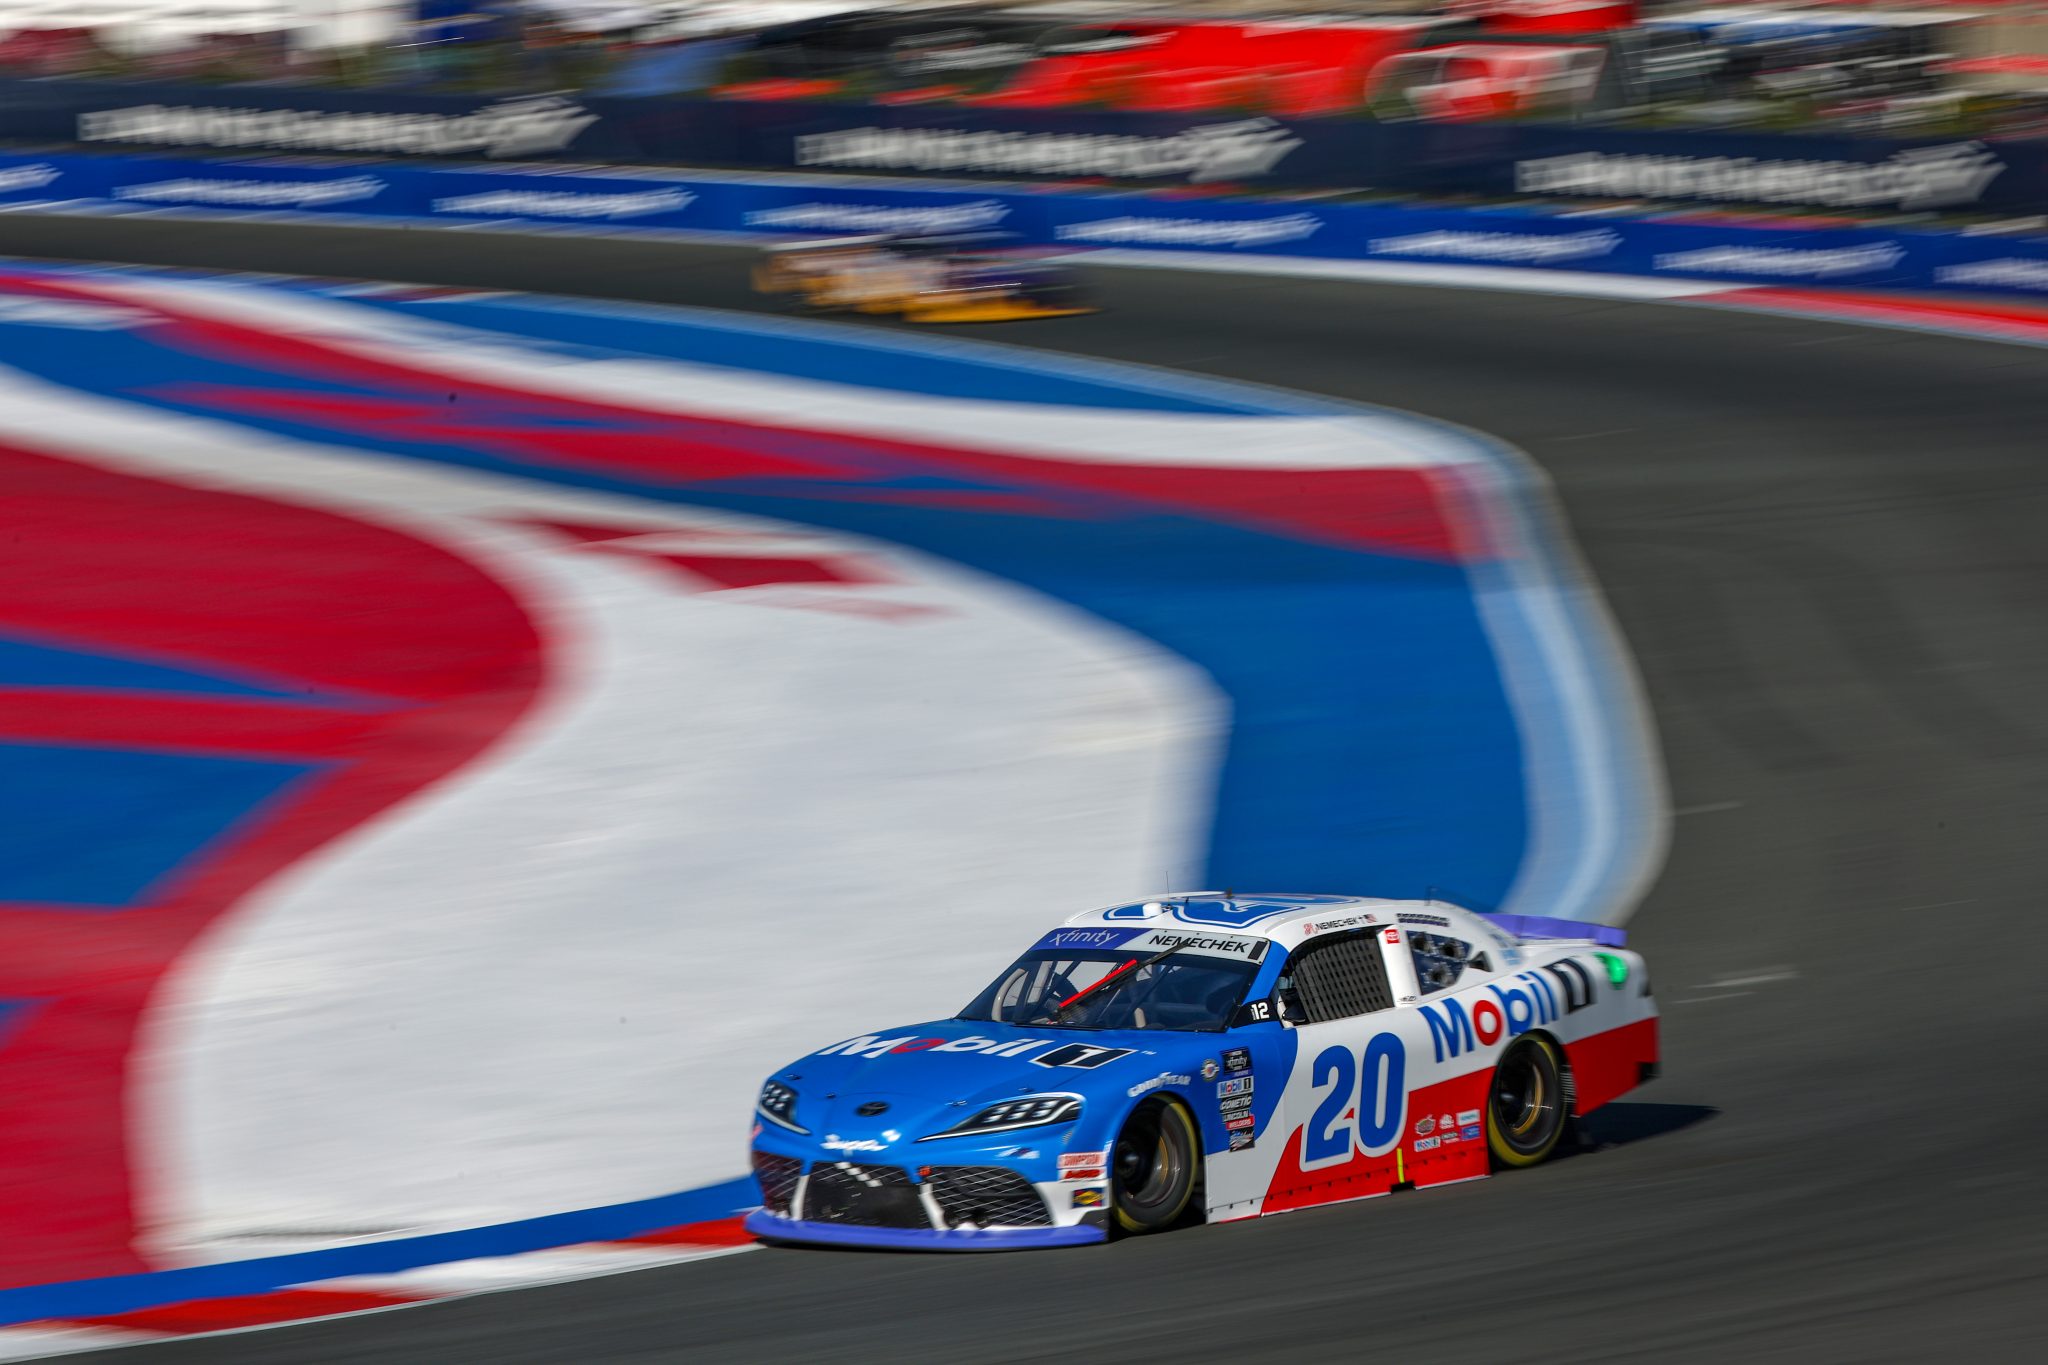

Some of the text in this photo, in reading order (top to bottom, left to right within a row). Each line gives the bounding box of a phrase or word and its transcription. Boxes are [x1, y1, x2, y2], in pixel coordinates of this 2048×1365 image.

[1049, 929, 1120, 947] xfinity
[1149, 935, 1250, 953] NEMECHEK
[1250, 1001, 1270, 1020] 12
[1417, 971, 1558, 1063] Mobil
[816, 1035, 1055, 1058] Mobil
[1304, 1032, 1406, 1163] 20
